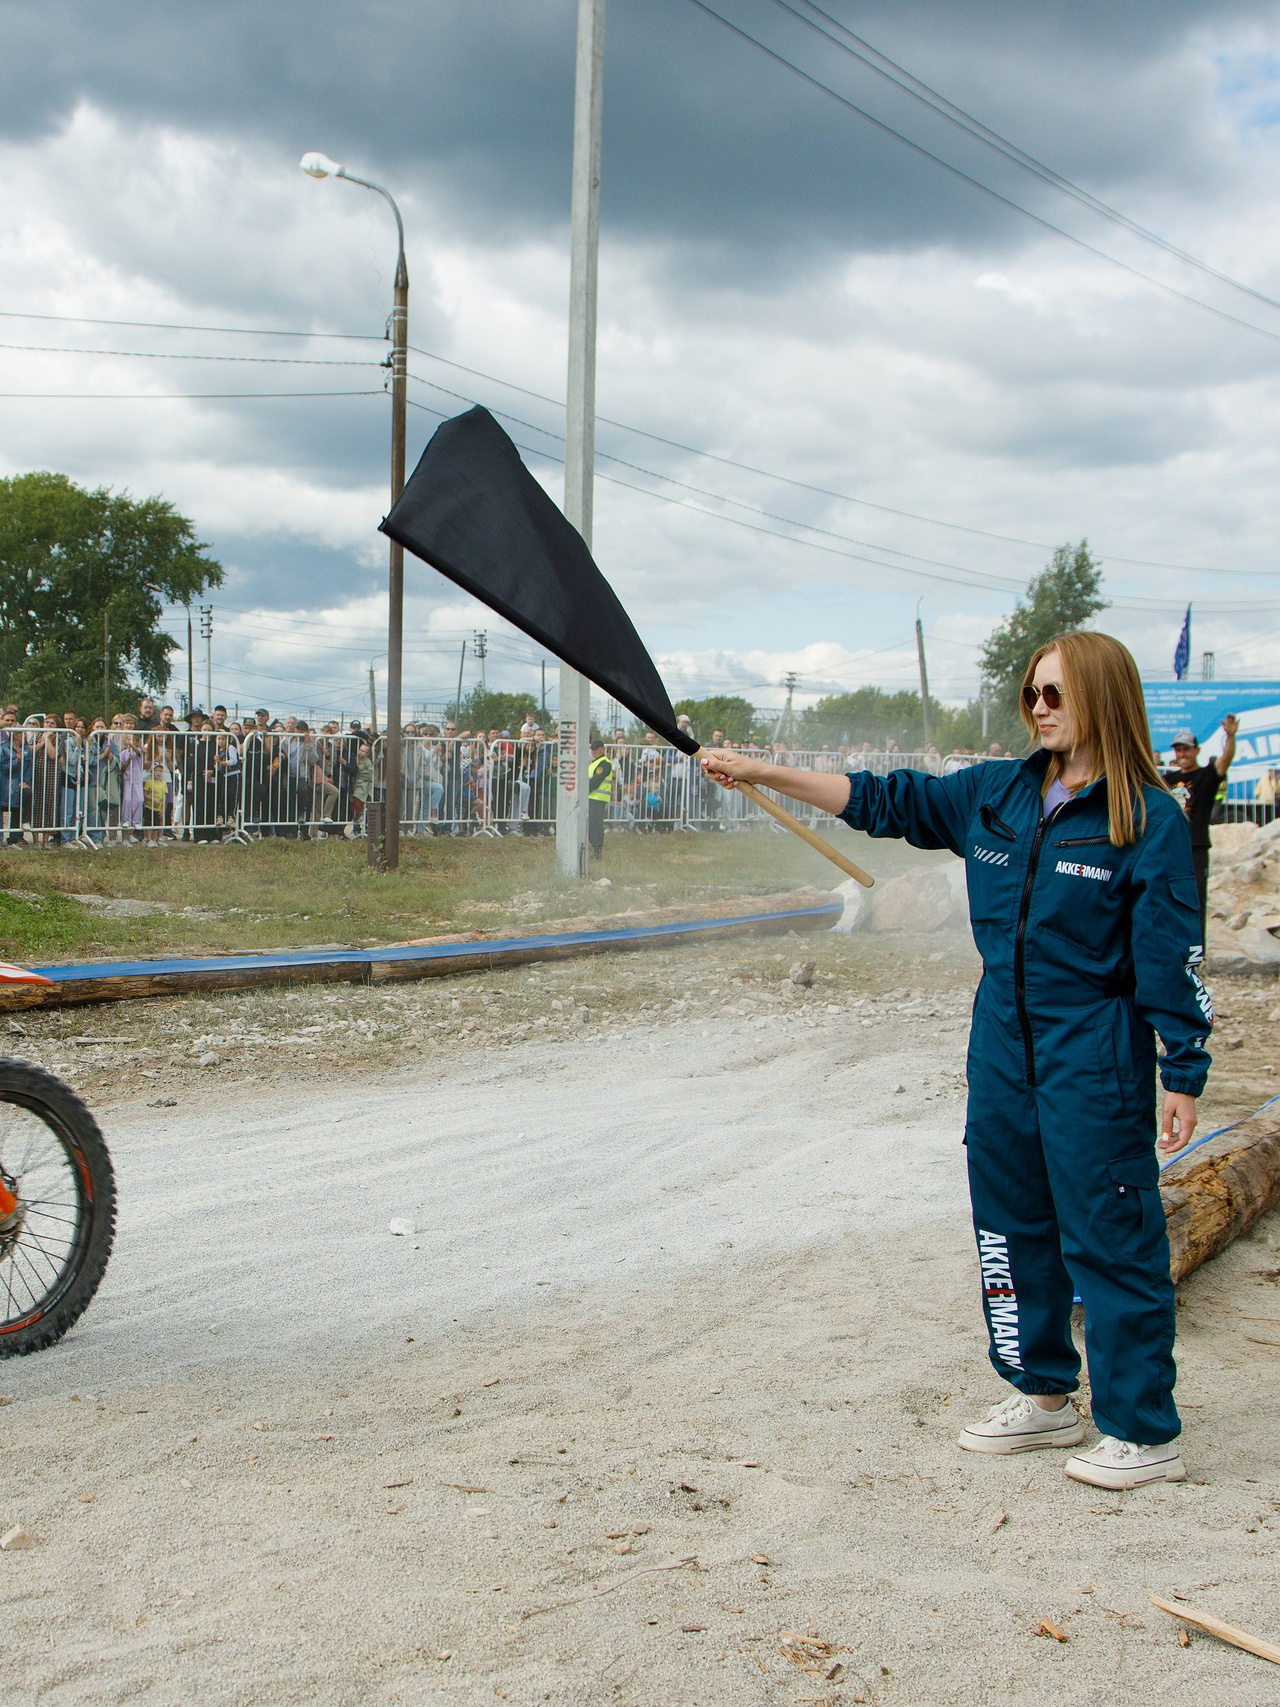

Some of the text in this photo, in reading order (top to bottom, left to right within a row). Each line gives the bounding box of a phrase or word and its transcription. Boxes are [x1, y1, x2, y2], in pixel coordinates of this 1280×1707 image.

[559, 721, 577, 792] FIRE CUP
[1055, 861, 1113, 882] AKKERMANN
[979, 1229, 1026, 1372] AKKERMANN
